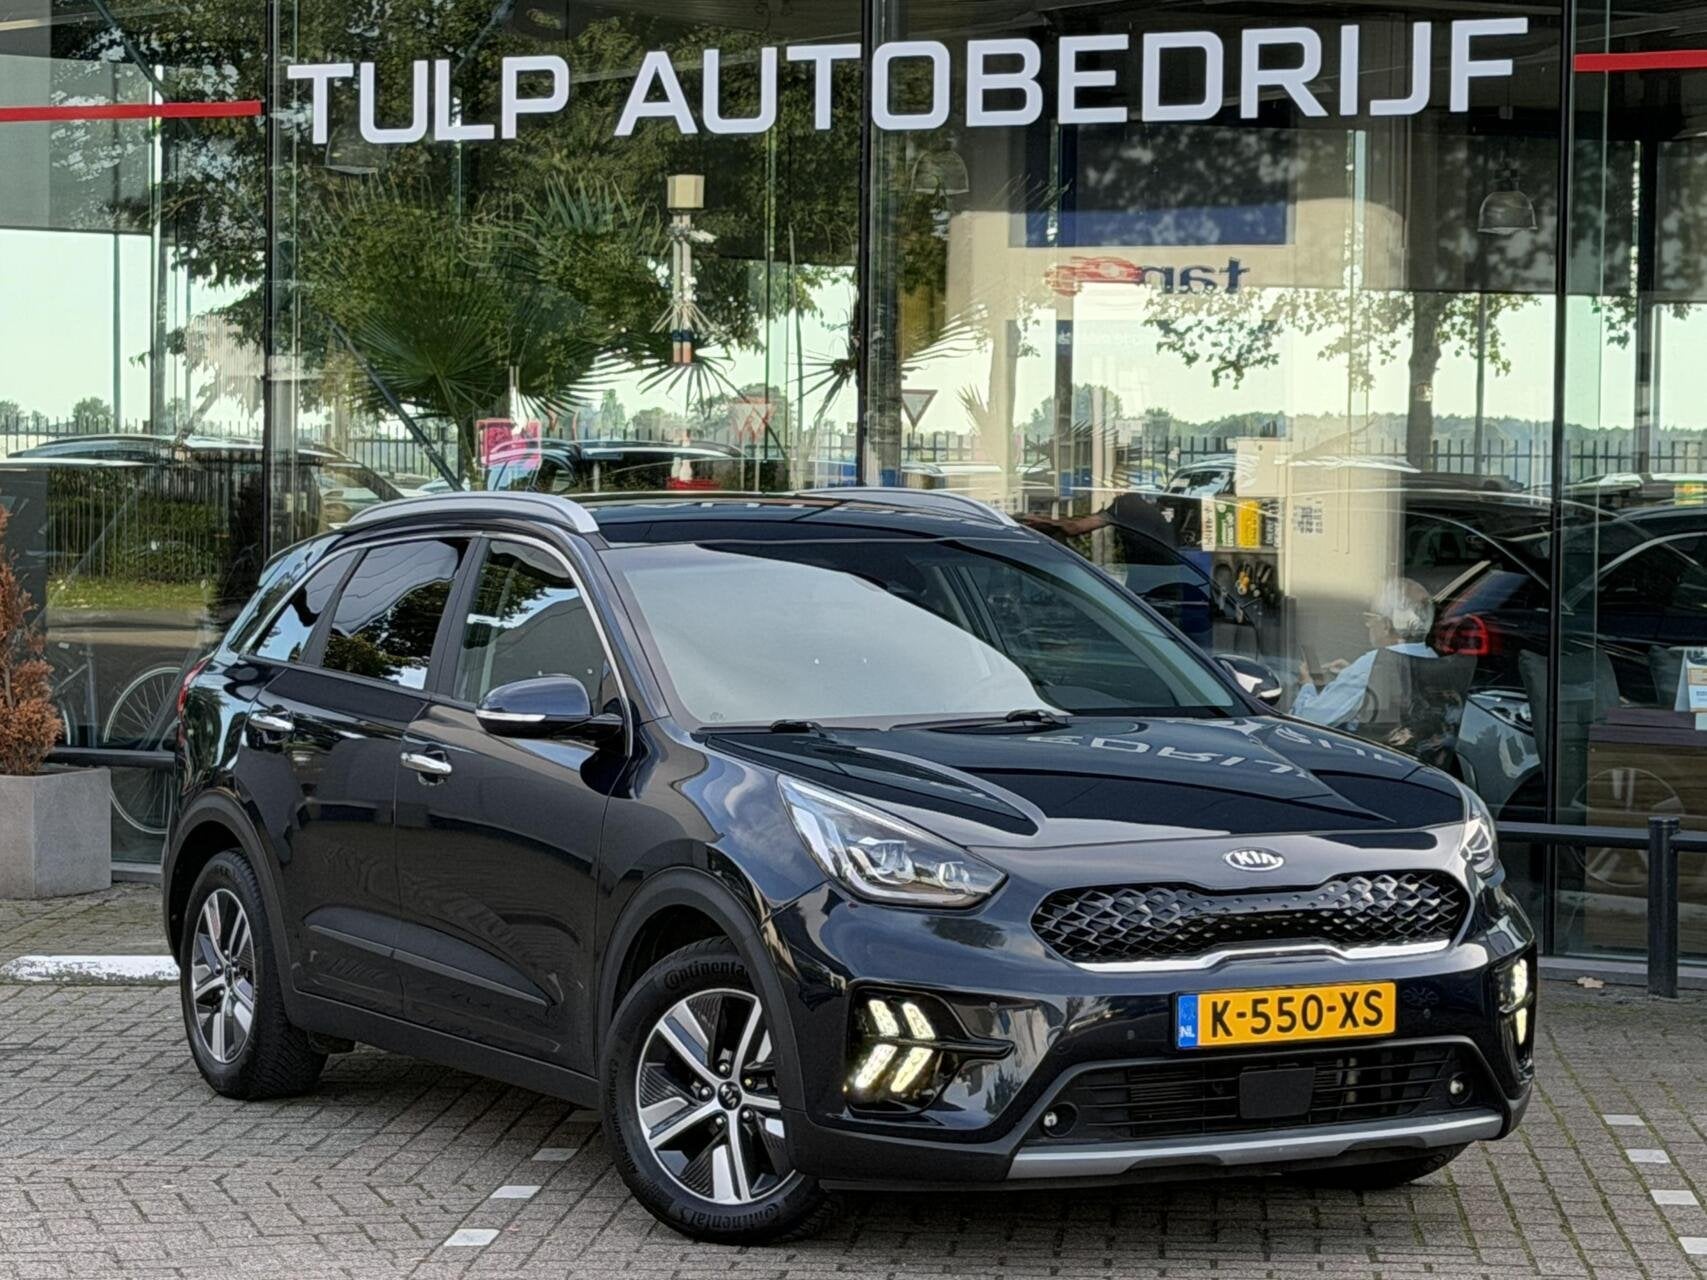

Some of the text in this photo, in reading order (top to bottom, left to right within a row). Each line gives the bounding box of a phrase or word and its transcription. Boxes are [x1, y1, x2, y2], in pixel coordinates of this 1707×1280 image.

[287, 17, 1529, 145] TULP AUTOBEDRIJF
[1179, 1025, 1195, 1038] NL
[1210, 989, 1384, 1038] K-550-XS
